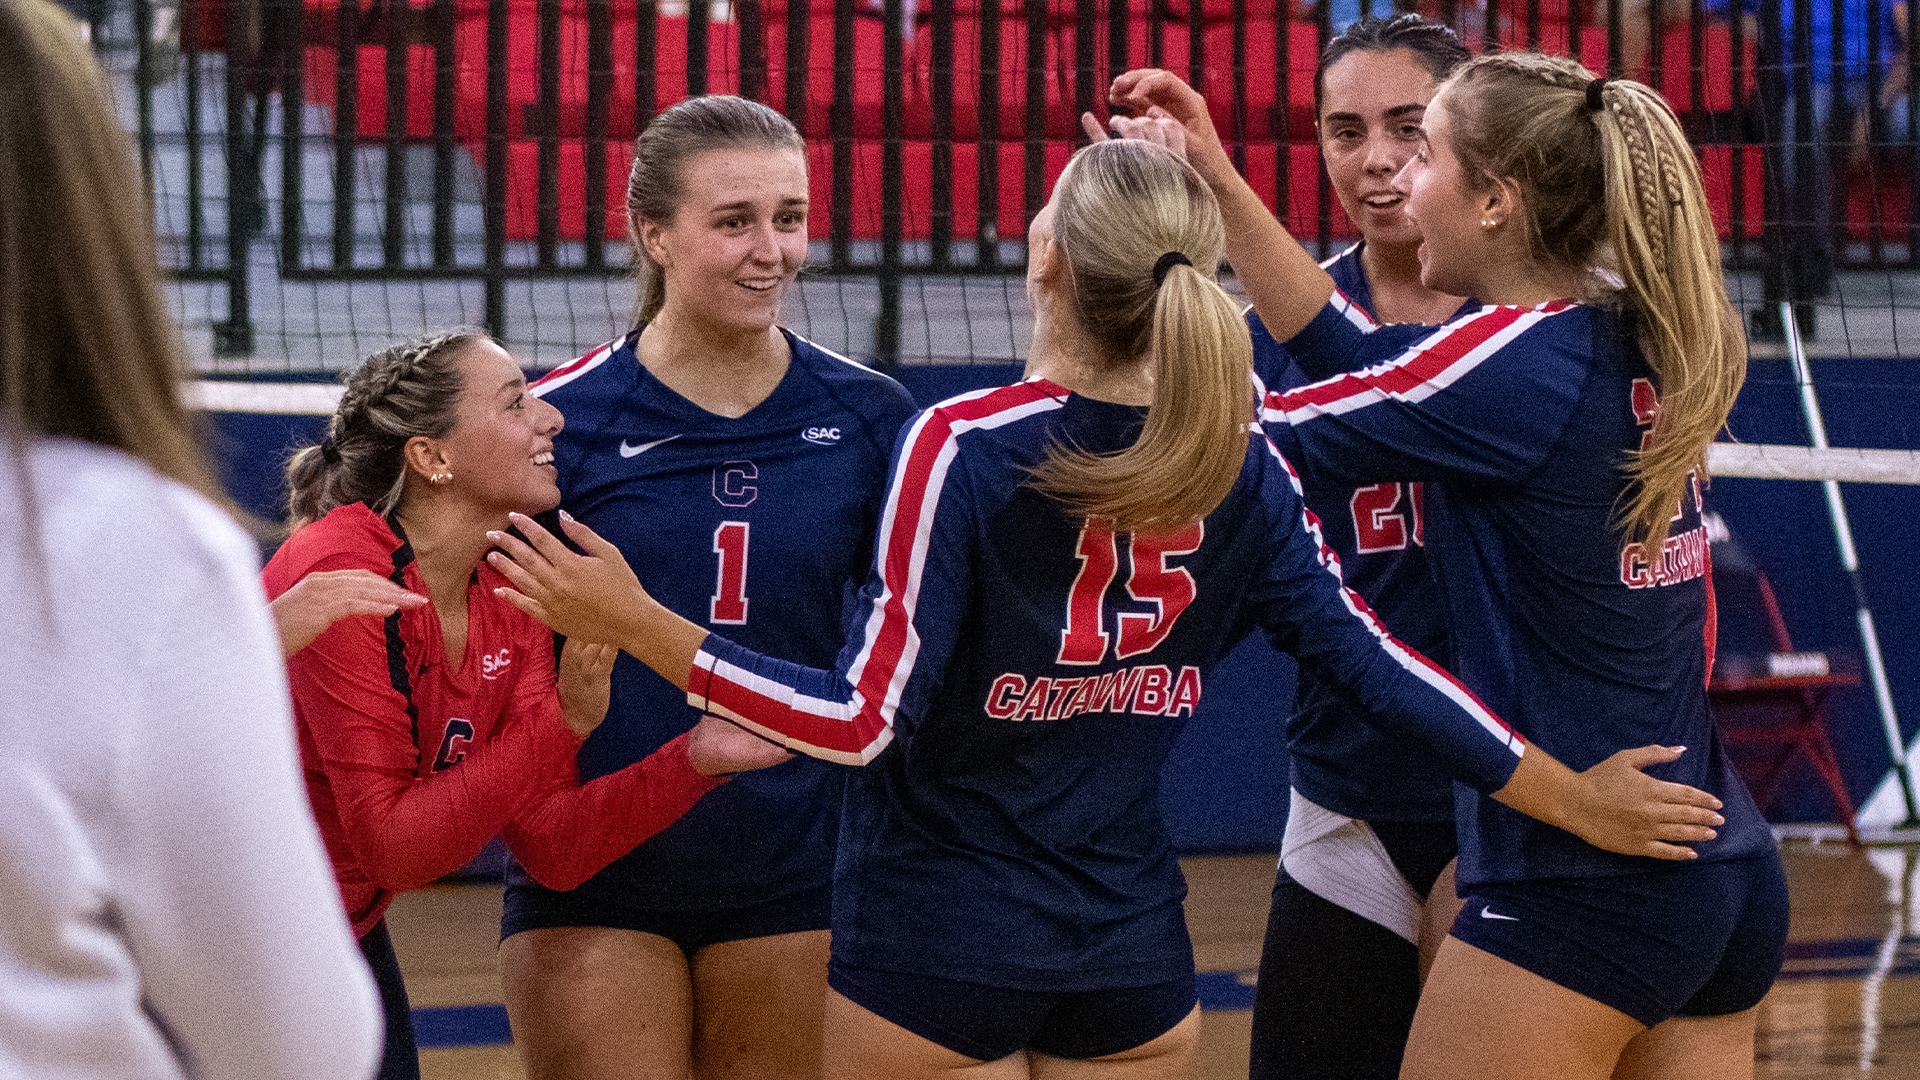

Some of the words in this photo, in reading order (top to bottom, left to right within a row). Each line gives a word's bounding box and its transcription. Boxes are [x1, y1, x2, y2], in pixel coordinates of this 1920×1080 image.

[806, 427, 841, 441] SAC
[712, 460, 758, 507] C
[710, 520, 750, 625] 1
[1621, 527, 1707, 589] CATAW
[1055, 514, 1204, 666] 15
[482, 648, 512, 675] SAC
[984, 664, 1202, 721] CATAWBA
[431, 717, 475, 773] C
